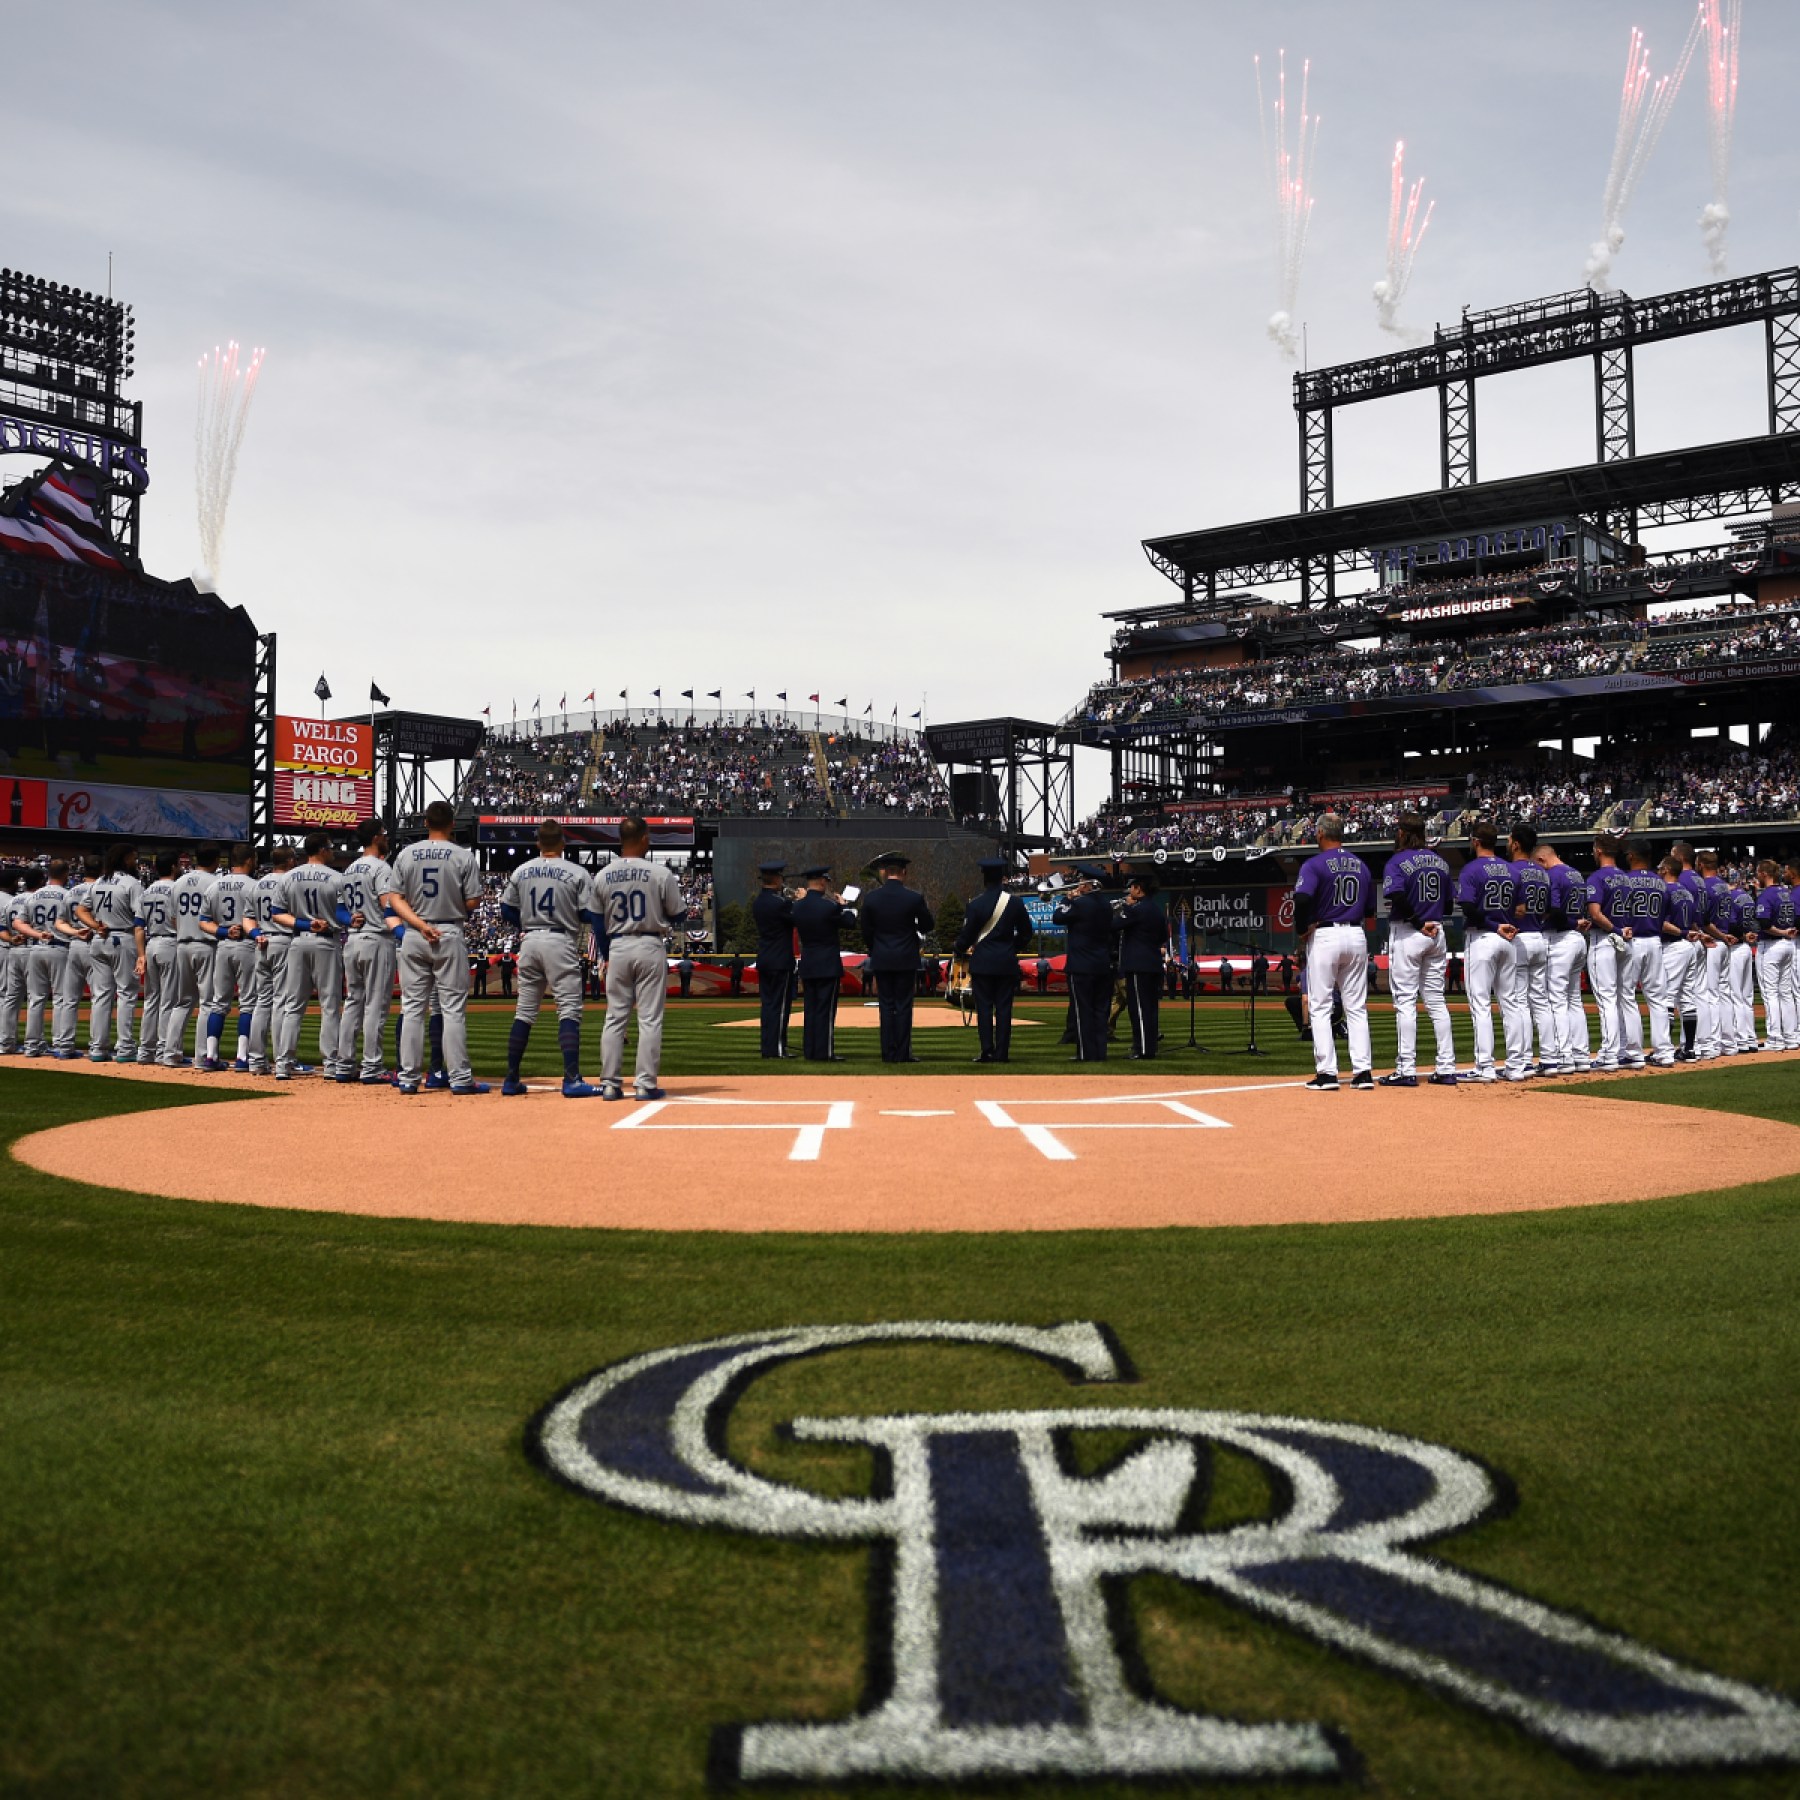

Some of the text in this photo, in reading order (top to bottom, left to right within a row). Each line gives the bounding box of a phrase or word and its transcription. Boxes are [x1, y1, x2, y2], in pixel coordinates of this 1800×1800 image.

[1370, 522, 1566, 573] THE ROOFTOP
[1401, 597, 1512, 622] SMASHBURGER
[1681, 672, 1695, 682] red
[1727, 667, 1743, 677] the
[1745, 664, 1780, 676] bombs
[291, 720, 358, 744] WELLS
[292, 743, 358, 766] FARGO
[293, 778, 356, 805] KING
[291, 800, 358, 827] Soopers
[412, 848, 452, 861] SEAGER
[1325, 856, 1362, 874] BLACK
[218, 881, 245, 892] TAYLOR
[291, 871, 332, 883] POLLOCK
[422, 867, 439, 898] 5
[517, 866, 574, 885] HERNANDEZ
[605, 867, 651, 884] ROBERTS
[1417, 871, 1441, 903] 19
[96, 891, 113, 913] 74
[304, 887, 319, 915] 11
[344, 881, 364, 910] 35
[529, 886, 556, 917] 14
[1194, 892, 1251, 911] Bank of
[1333, 874, 1360, 907] 10
[1483, 880, 1514, 910] 26
[1525, 884, 1548, 915] 28
[1565, 886, 1588, 915] 27
[34, 904, 58, 926] 64
[143, 901, 166, 924] 75
[179, 892, 202, 916] 99
[221, 896, 235, 922] 3
[257, 896, 272, 921] 13
[611, 890, 646, 922] 30
[1632, 890, 1662, 919] 20
[1193, 910, 1264, 929] Colorado
